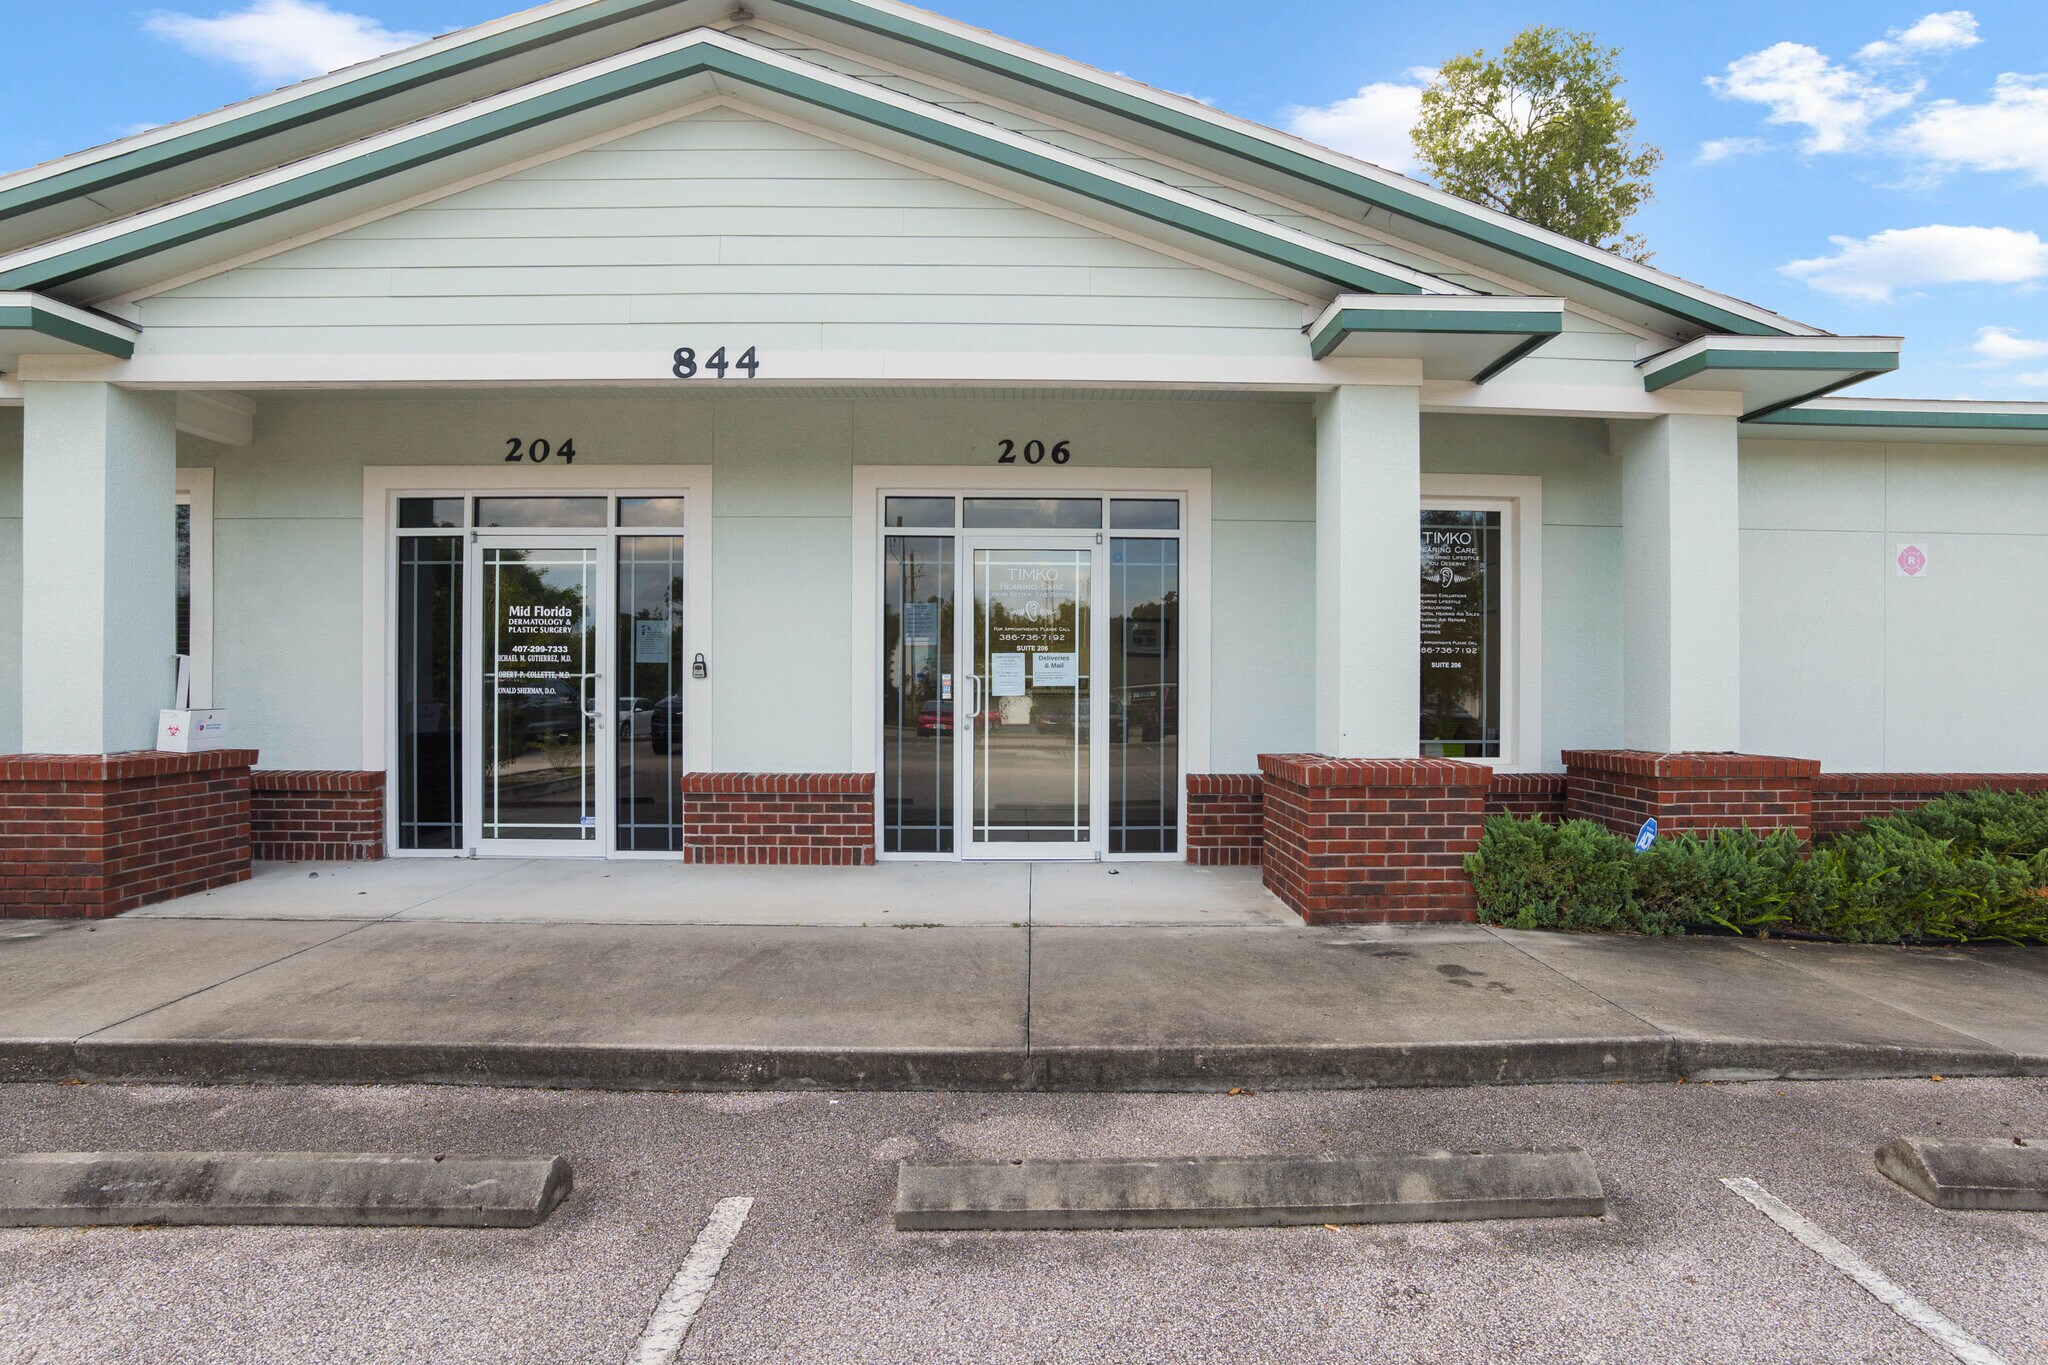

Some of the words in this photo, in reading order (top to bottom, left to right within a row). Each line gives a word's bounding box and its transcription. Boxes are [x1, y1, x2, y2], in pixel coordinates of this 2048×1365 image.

[672, 346, 760, 379] 844
[505, 438, 576, 464] 204
[998, 439, 1070, 464] 206
[1422, 531, 1472, 545] TIMKO
[1420, 546, 1452, 554] EARING
[1454, 546, 1477, 554] CARE
[1908, 556, 1916, 565] R
[1007, 568, 1059, 581] TIMKO
[1040, 582, 1065, 590] CARE
[509, 605, 531, 617] Mid
[534, 605, 572, 617] Florida
[512, 645, 568, 653] 407-299-7333
[527, 654, 560, 663] GUTIERREZ,
[560, 654, 572, 662] M.D.
[526, 671, 557, 680] COLLETTE,
[517, 687, 544, 695] SHERMAN,
[1637, 831, 1655, 850] ADT
